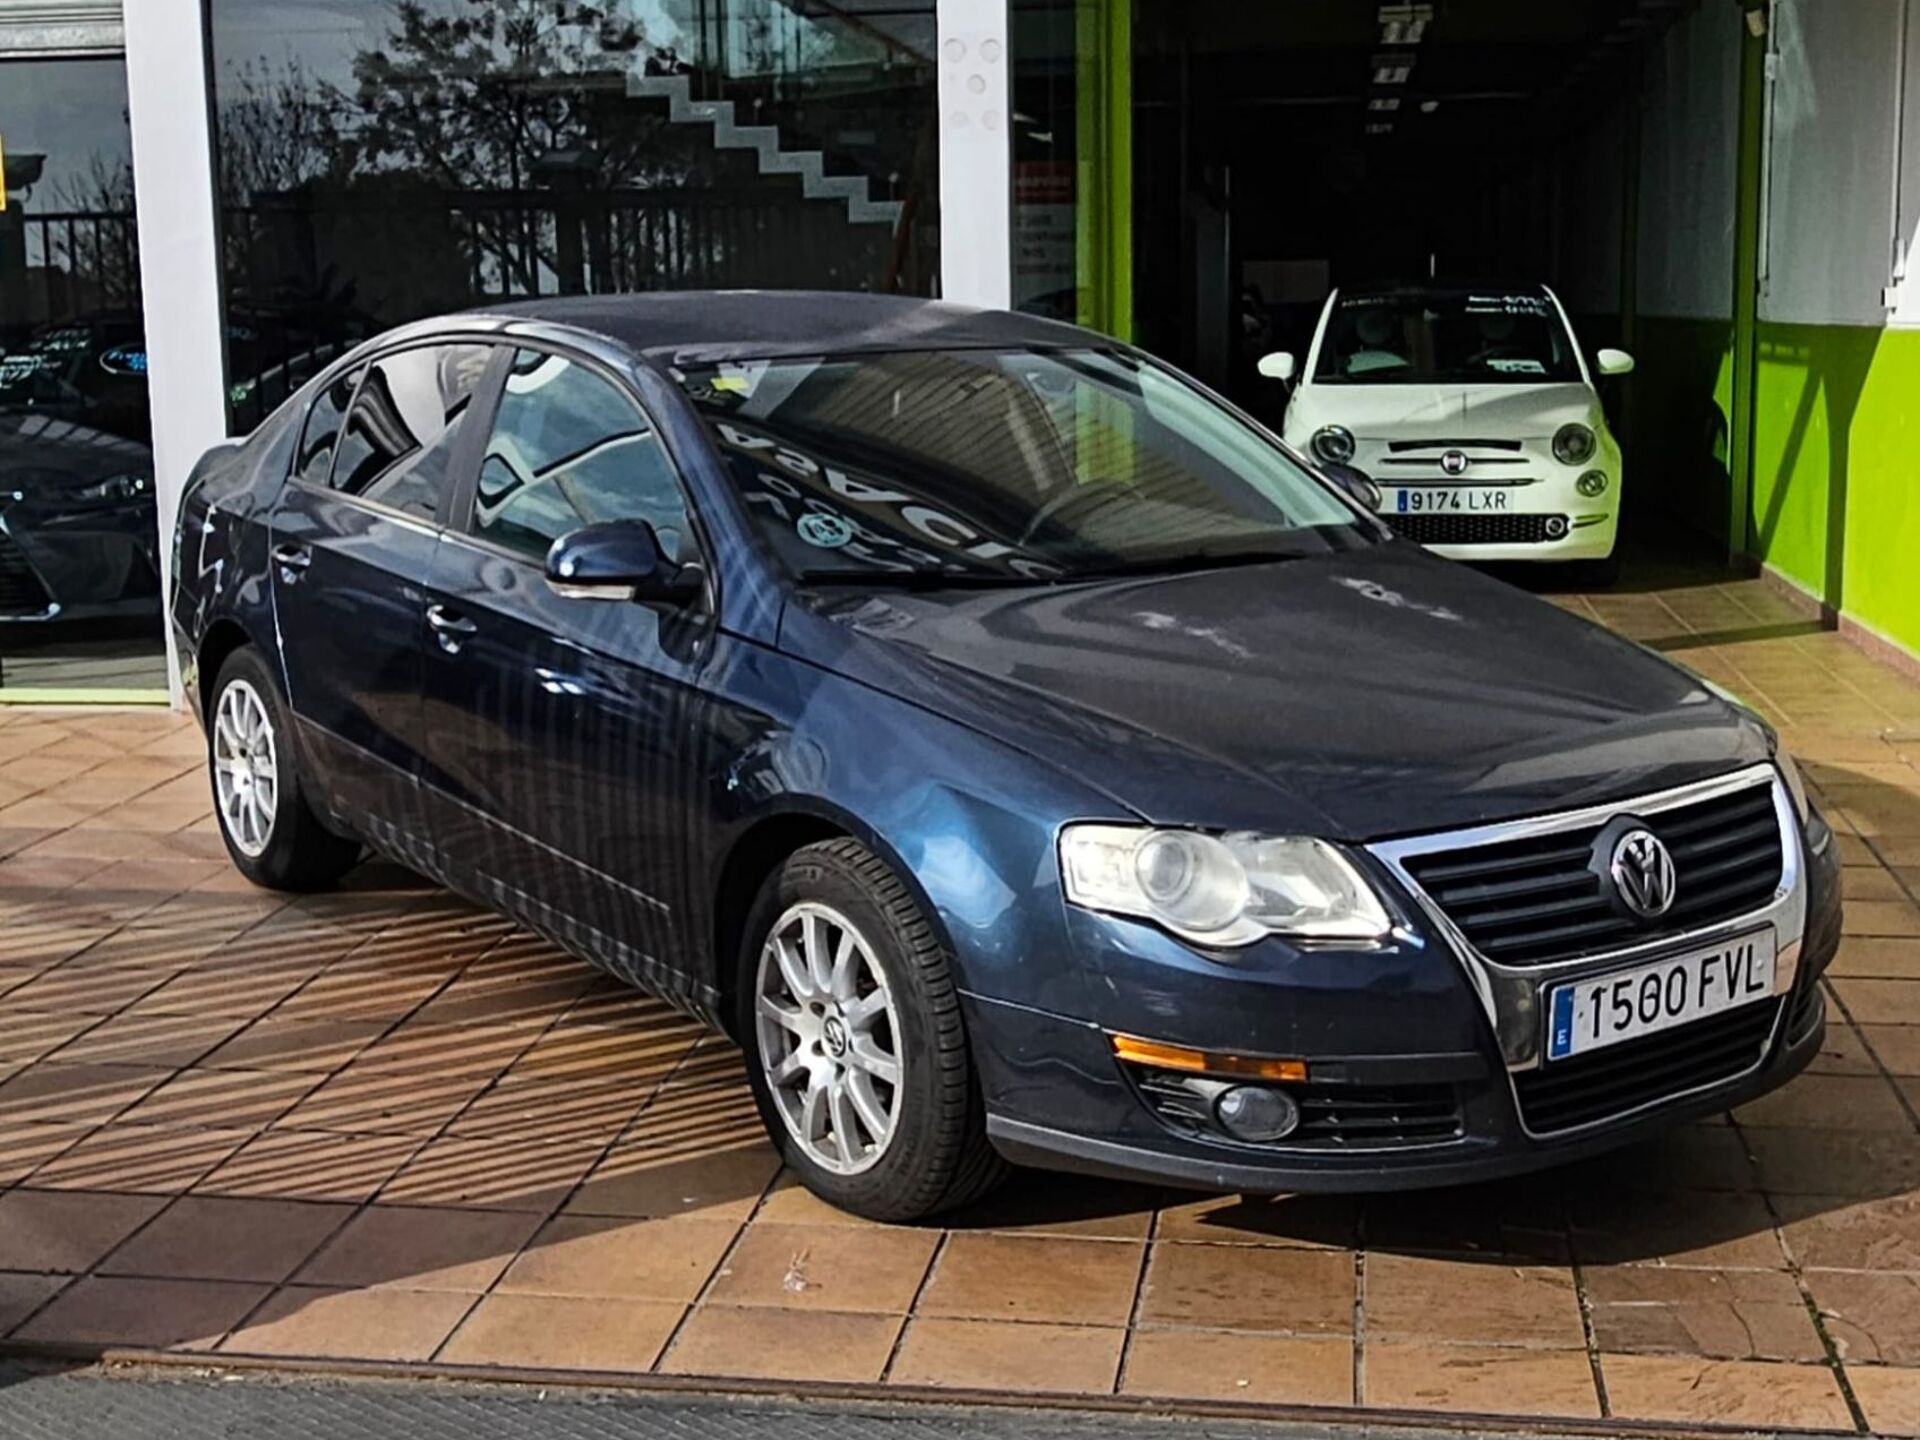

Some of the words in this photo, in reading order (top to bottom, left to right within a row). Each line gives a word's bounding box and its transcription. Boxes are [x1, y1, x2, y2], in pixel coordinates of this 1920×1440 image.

[1411, 491, 1460, 511] 9174
[1469, 491, 1506, 510] LXR
[1557, 1029, 1567, 1045] E
[1699, 944, 1765, 1008] FVL
